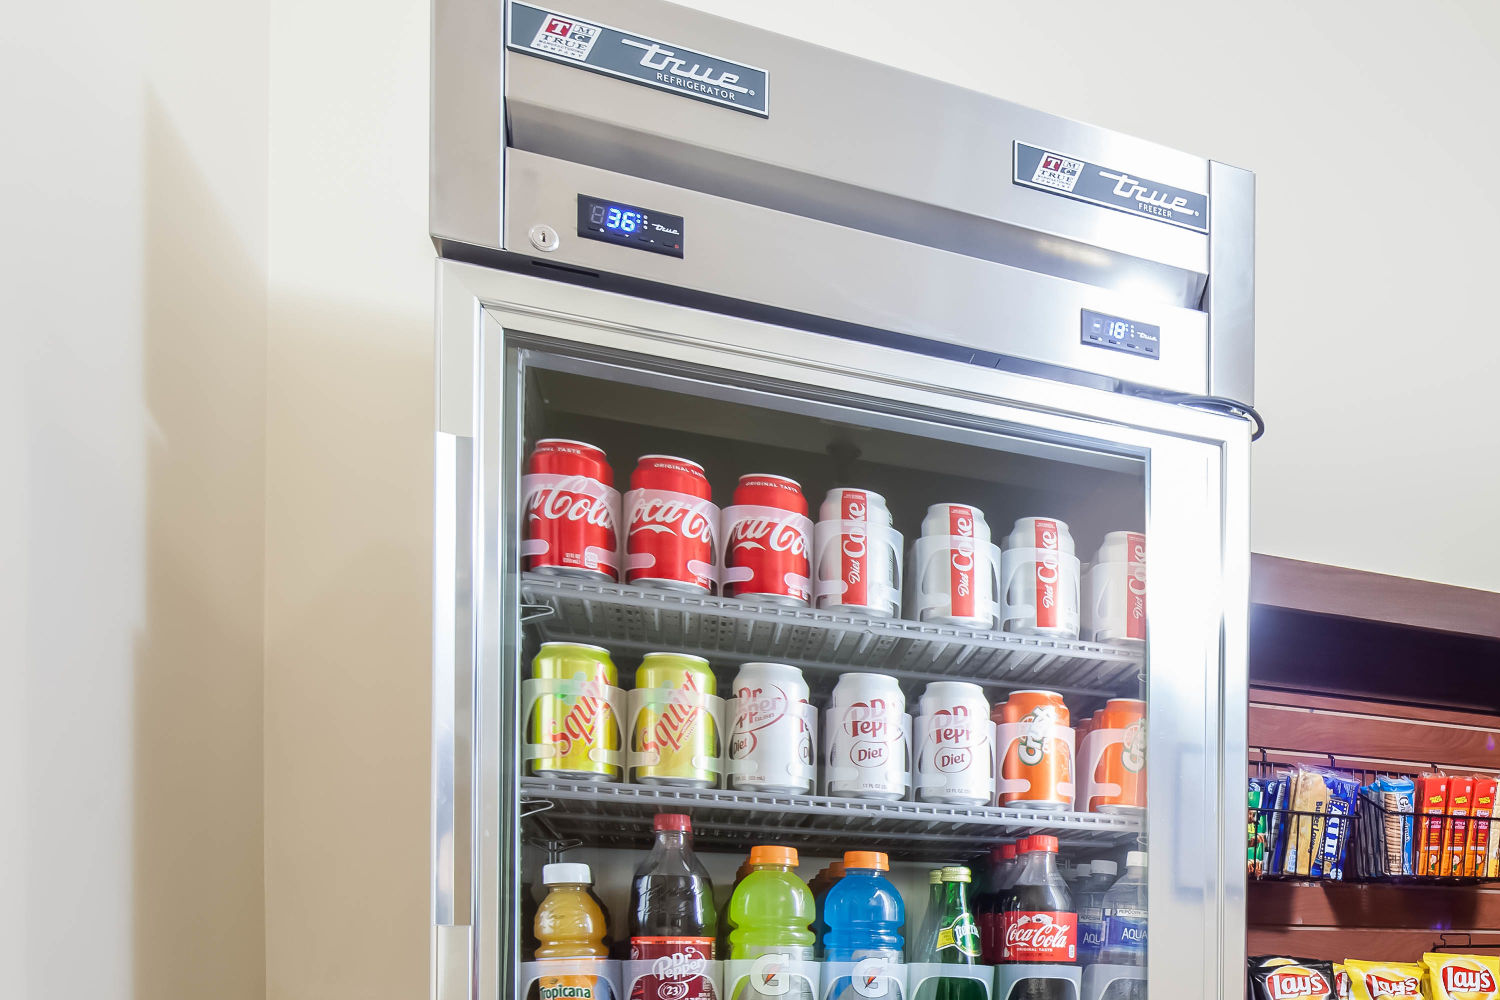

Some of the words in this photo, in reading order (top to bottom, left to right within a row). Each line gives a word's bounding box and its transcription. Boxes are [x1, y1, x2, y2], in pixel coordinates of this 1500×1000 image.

[541, 33, 588, 50] TRUE
[622, 38, 749, 94] true
[656, 72, 736, 101] REFRIGERATOR
[1040, 170, 1073, 182] TRUE
[1099, 171, 1194, 216] true
[606, 207, 636, 232] 36
[1138, 203, 1172, 218] FREEZER
[843, 502, 866, 559] Coke
[952, 517, 973, 573] Coke
[1038, 530, 1057, 583] Coke
[848, 559, 862, 585] Diet
[959, 573, 970, 598] Diet
[1043, 584, 1055, 609] Diet
[551, 662, 611, 756] Squirt
[641, 670, 699, 756] Squirt
[858, 747, 883, 763] Diet
[941, 754, 966, 769] Diet
[1005, 920, 1071, 949] Coca-Cola
[658, 958, 702, 981] Pepper
[672, 952, 693, 966] Dr
[540, 984, 591, 1000] Tropicana
[665, 985, 679, 996] 23
[1274, 974, 1325, 1000] Lay's
[1374, 976, 1419, 1000] Lay's
[1448, 966, 1496, 993] Lay's
